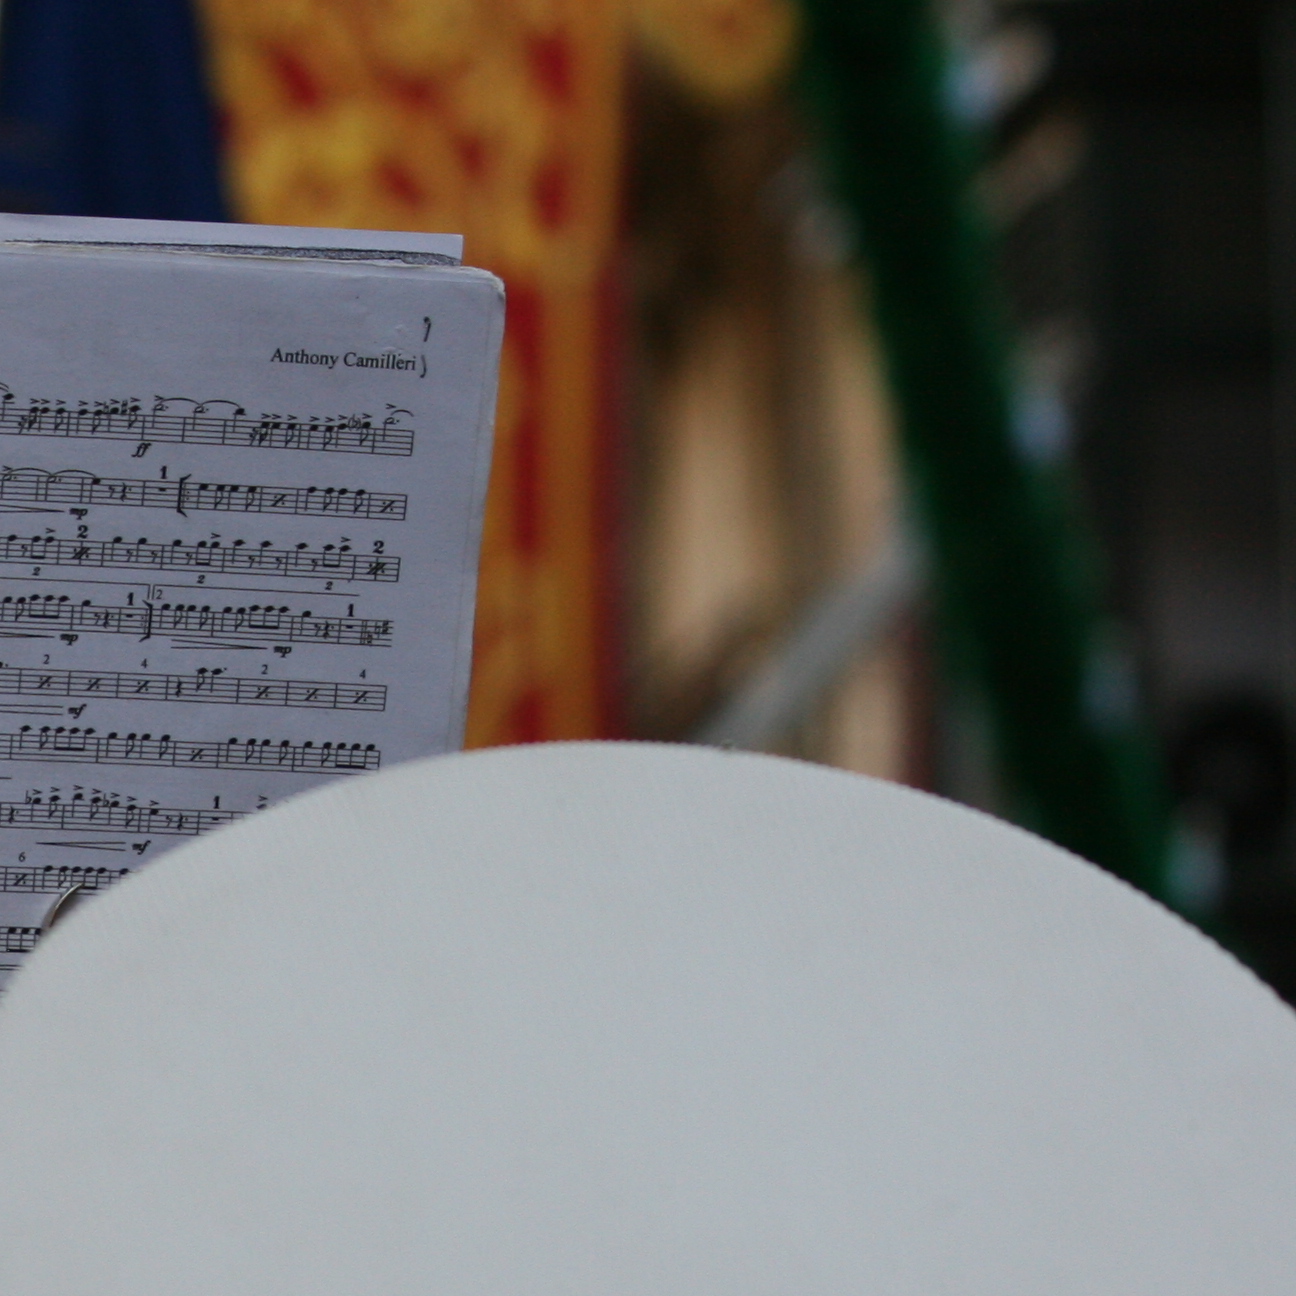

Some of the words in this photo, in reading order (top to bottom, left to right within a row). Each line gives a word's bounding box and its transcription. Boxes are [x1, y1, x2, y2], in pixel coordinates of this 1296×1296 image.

[270, 347, 339, 370] Anthony
[342, 351, 416, 371] Camilleri
[76, 525, 89, 540] 2
[372, 541, 385, 555] 2
